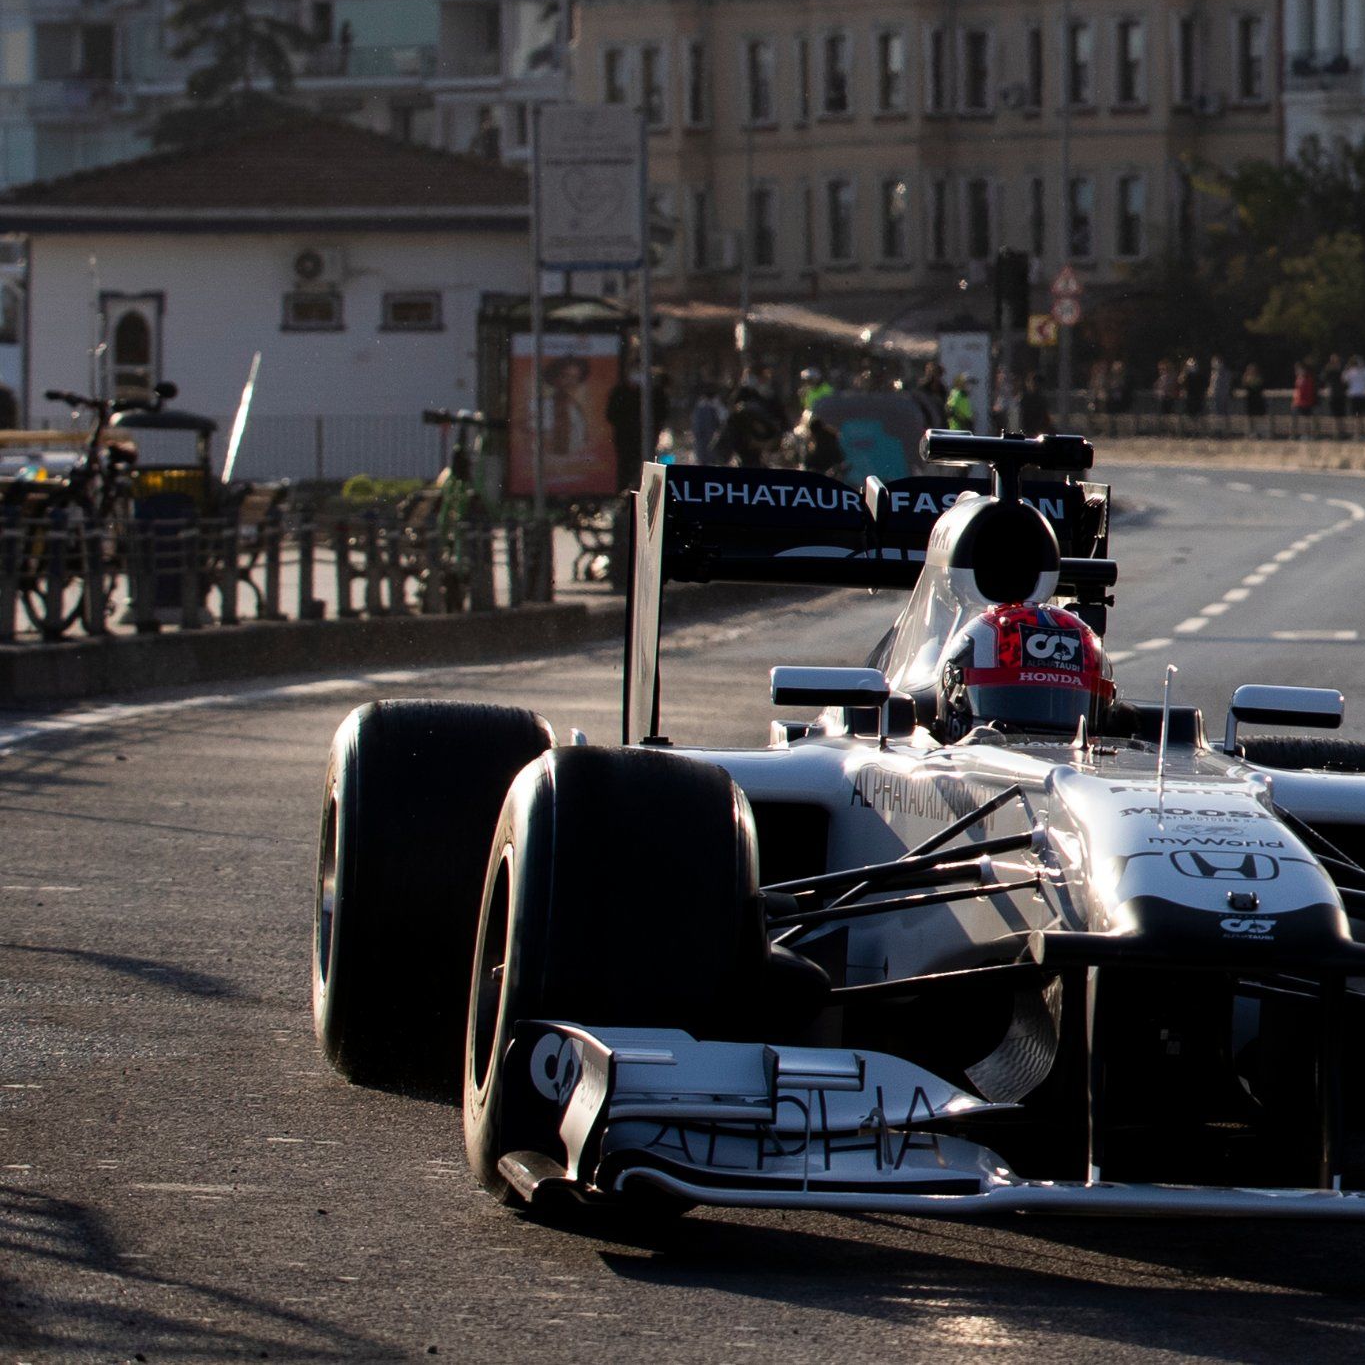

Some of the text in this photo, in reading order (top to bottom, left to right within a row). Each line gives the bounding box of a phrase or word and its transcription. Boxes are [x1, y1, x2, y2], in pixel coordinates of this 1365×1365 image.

[668, 479, 863, 512] ALPHATAUR
[1019, 672, 1083, 686] HONDA
[1148, 837, 1285, 848] myWorld
